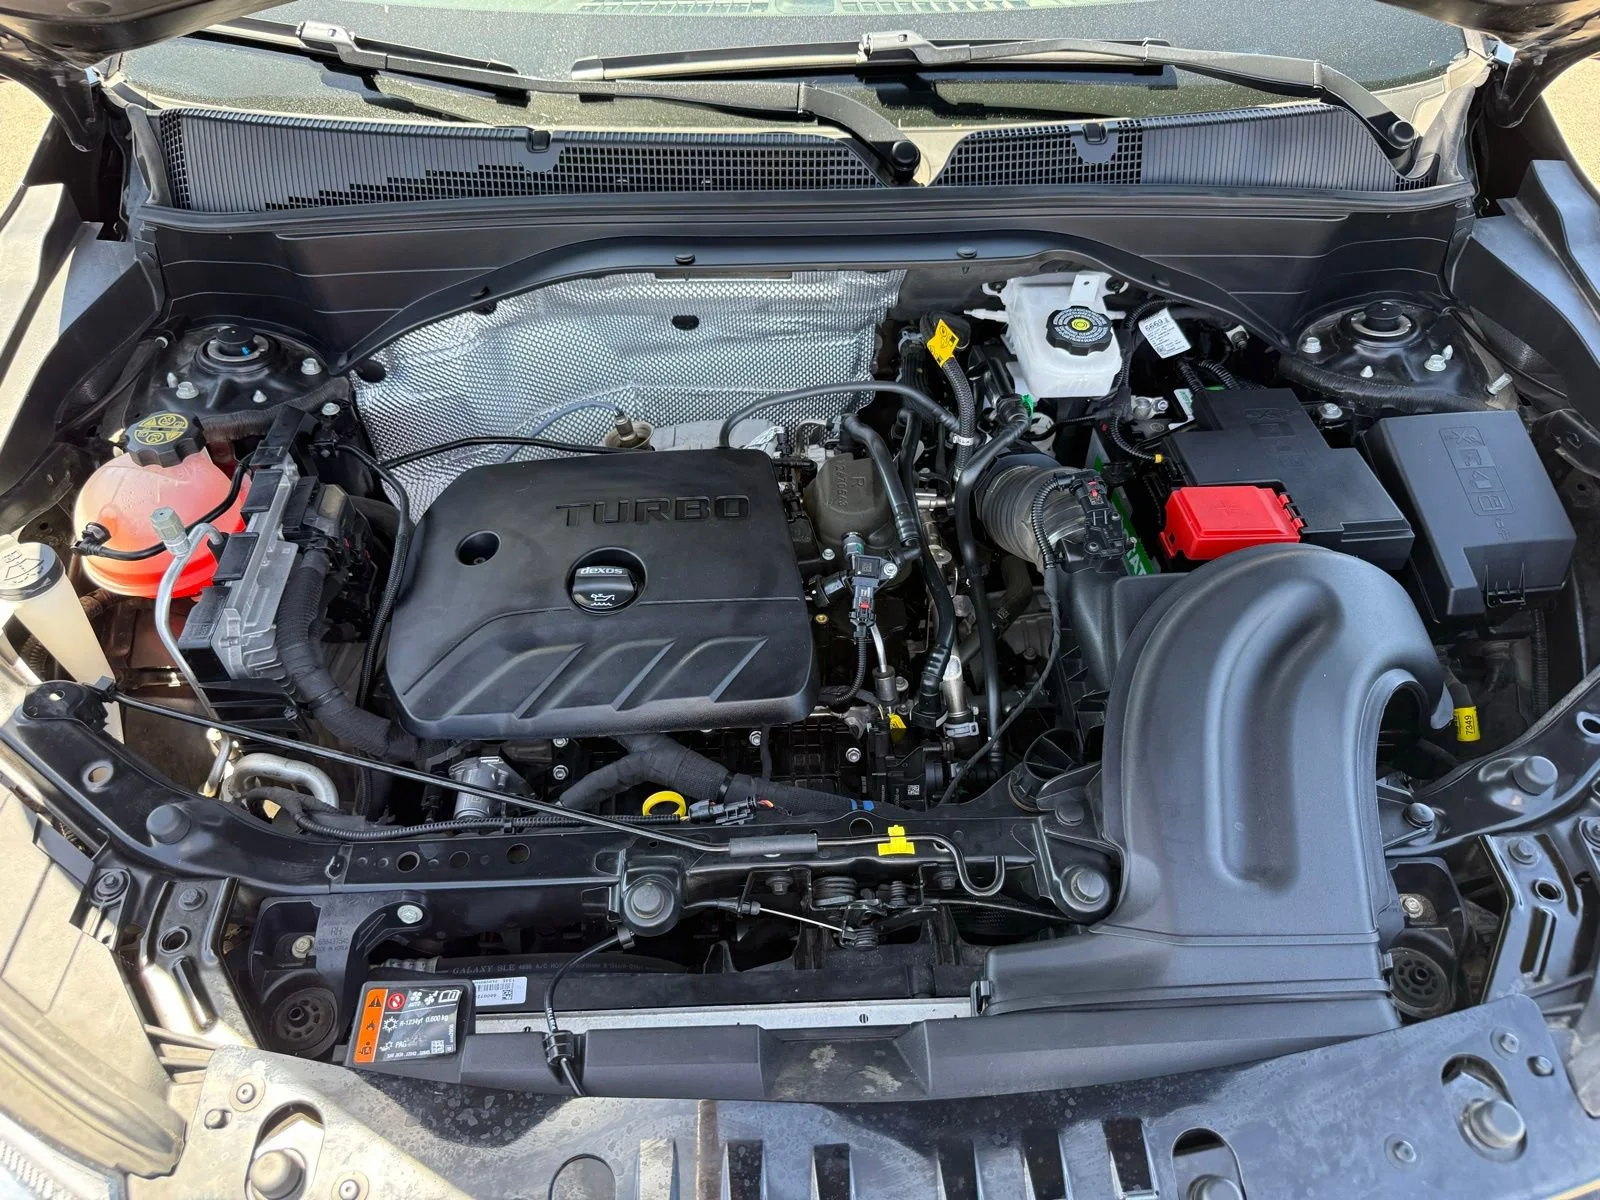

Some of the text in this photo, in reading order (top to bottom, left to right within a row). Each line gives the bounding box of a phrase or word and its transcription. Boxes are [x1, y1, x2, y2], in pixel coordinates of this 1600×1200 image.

[555, 494, 750, 527] TURBO
[580, 566, 623, 575] dexos
[452, 965, 493, 975] GALAXY
